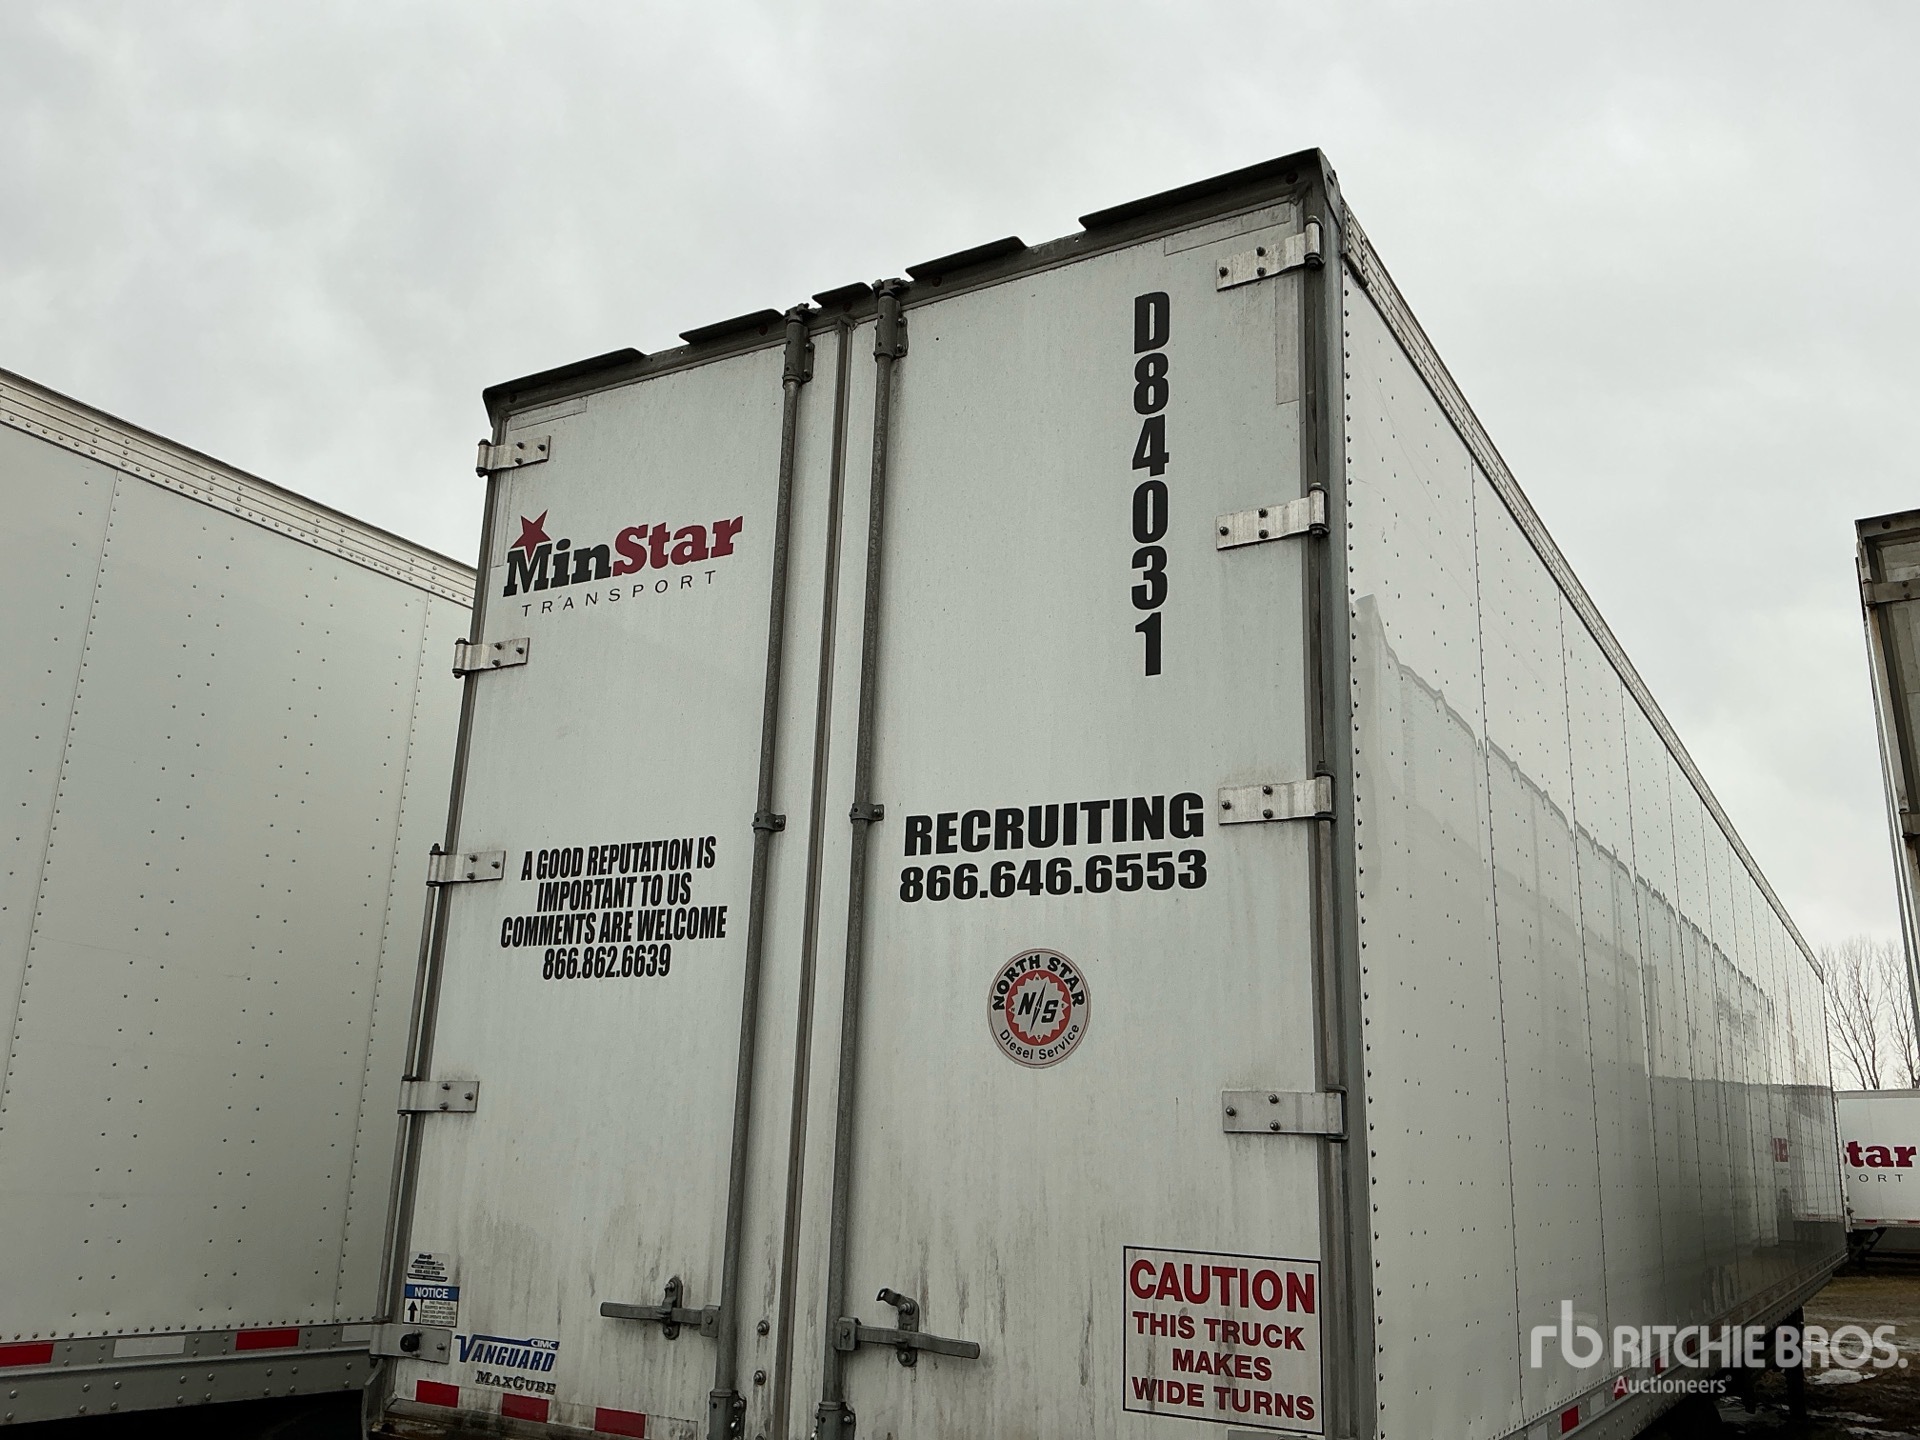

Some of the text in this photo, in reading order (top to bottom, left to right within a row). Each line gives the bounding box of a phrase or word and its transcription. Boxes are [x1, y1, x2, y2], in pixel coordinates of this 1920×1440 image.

[1131, 291, 1170, 676] D84031
[503, 515, 743, 597] MinStar
[522, 570, 716, 617] TRANSPORT
[904, 792, 1204, 856] RECRUITING
[521, 836, 717, 881] A GOOD REPUTATION IS
[900, 849, 1207, 903] 866.646.6553
[536, 872, 692, 912] IMPORTANT TO US
[501, 906, 728, 948] COMMENTS ARE WELCOME
[542, 944, 672, 980] 866.862.6639
[992, 954, 1086, 1012] NORTH STAR
[1000, 1024, 1080, 1061] Diesel Service
[1843, 1140, 1917, 1168] tar
[414, 1286, 449, 1299] NOTICE
[1130, 1259, 1315, 1314] CAUTION
[530, 1338, 557, 1350] CIMC
[1132, 1311, 1305, 1350] THIS TRUCK
[454, 1334, 557, 1372] VANGUARD
[1172, 1348, 1272, 1381] MAKES
[1132, 1376, 1315, 1420] WIDE TURNS
